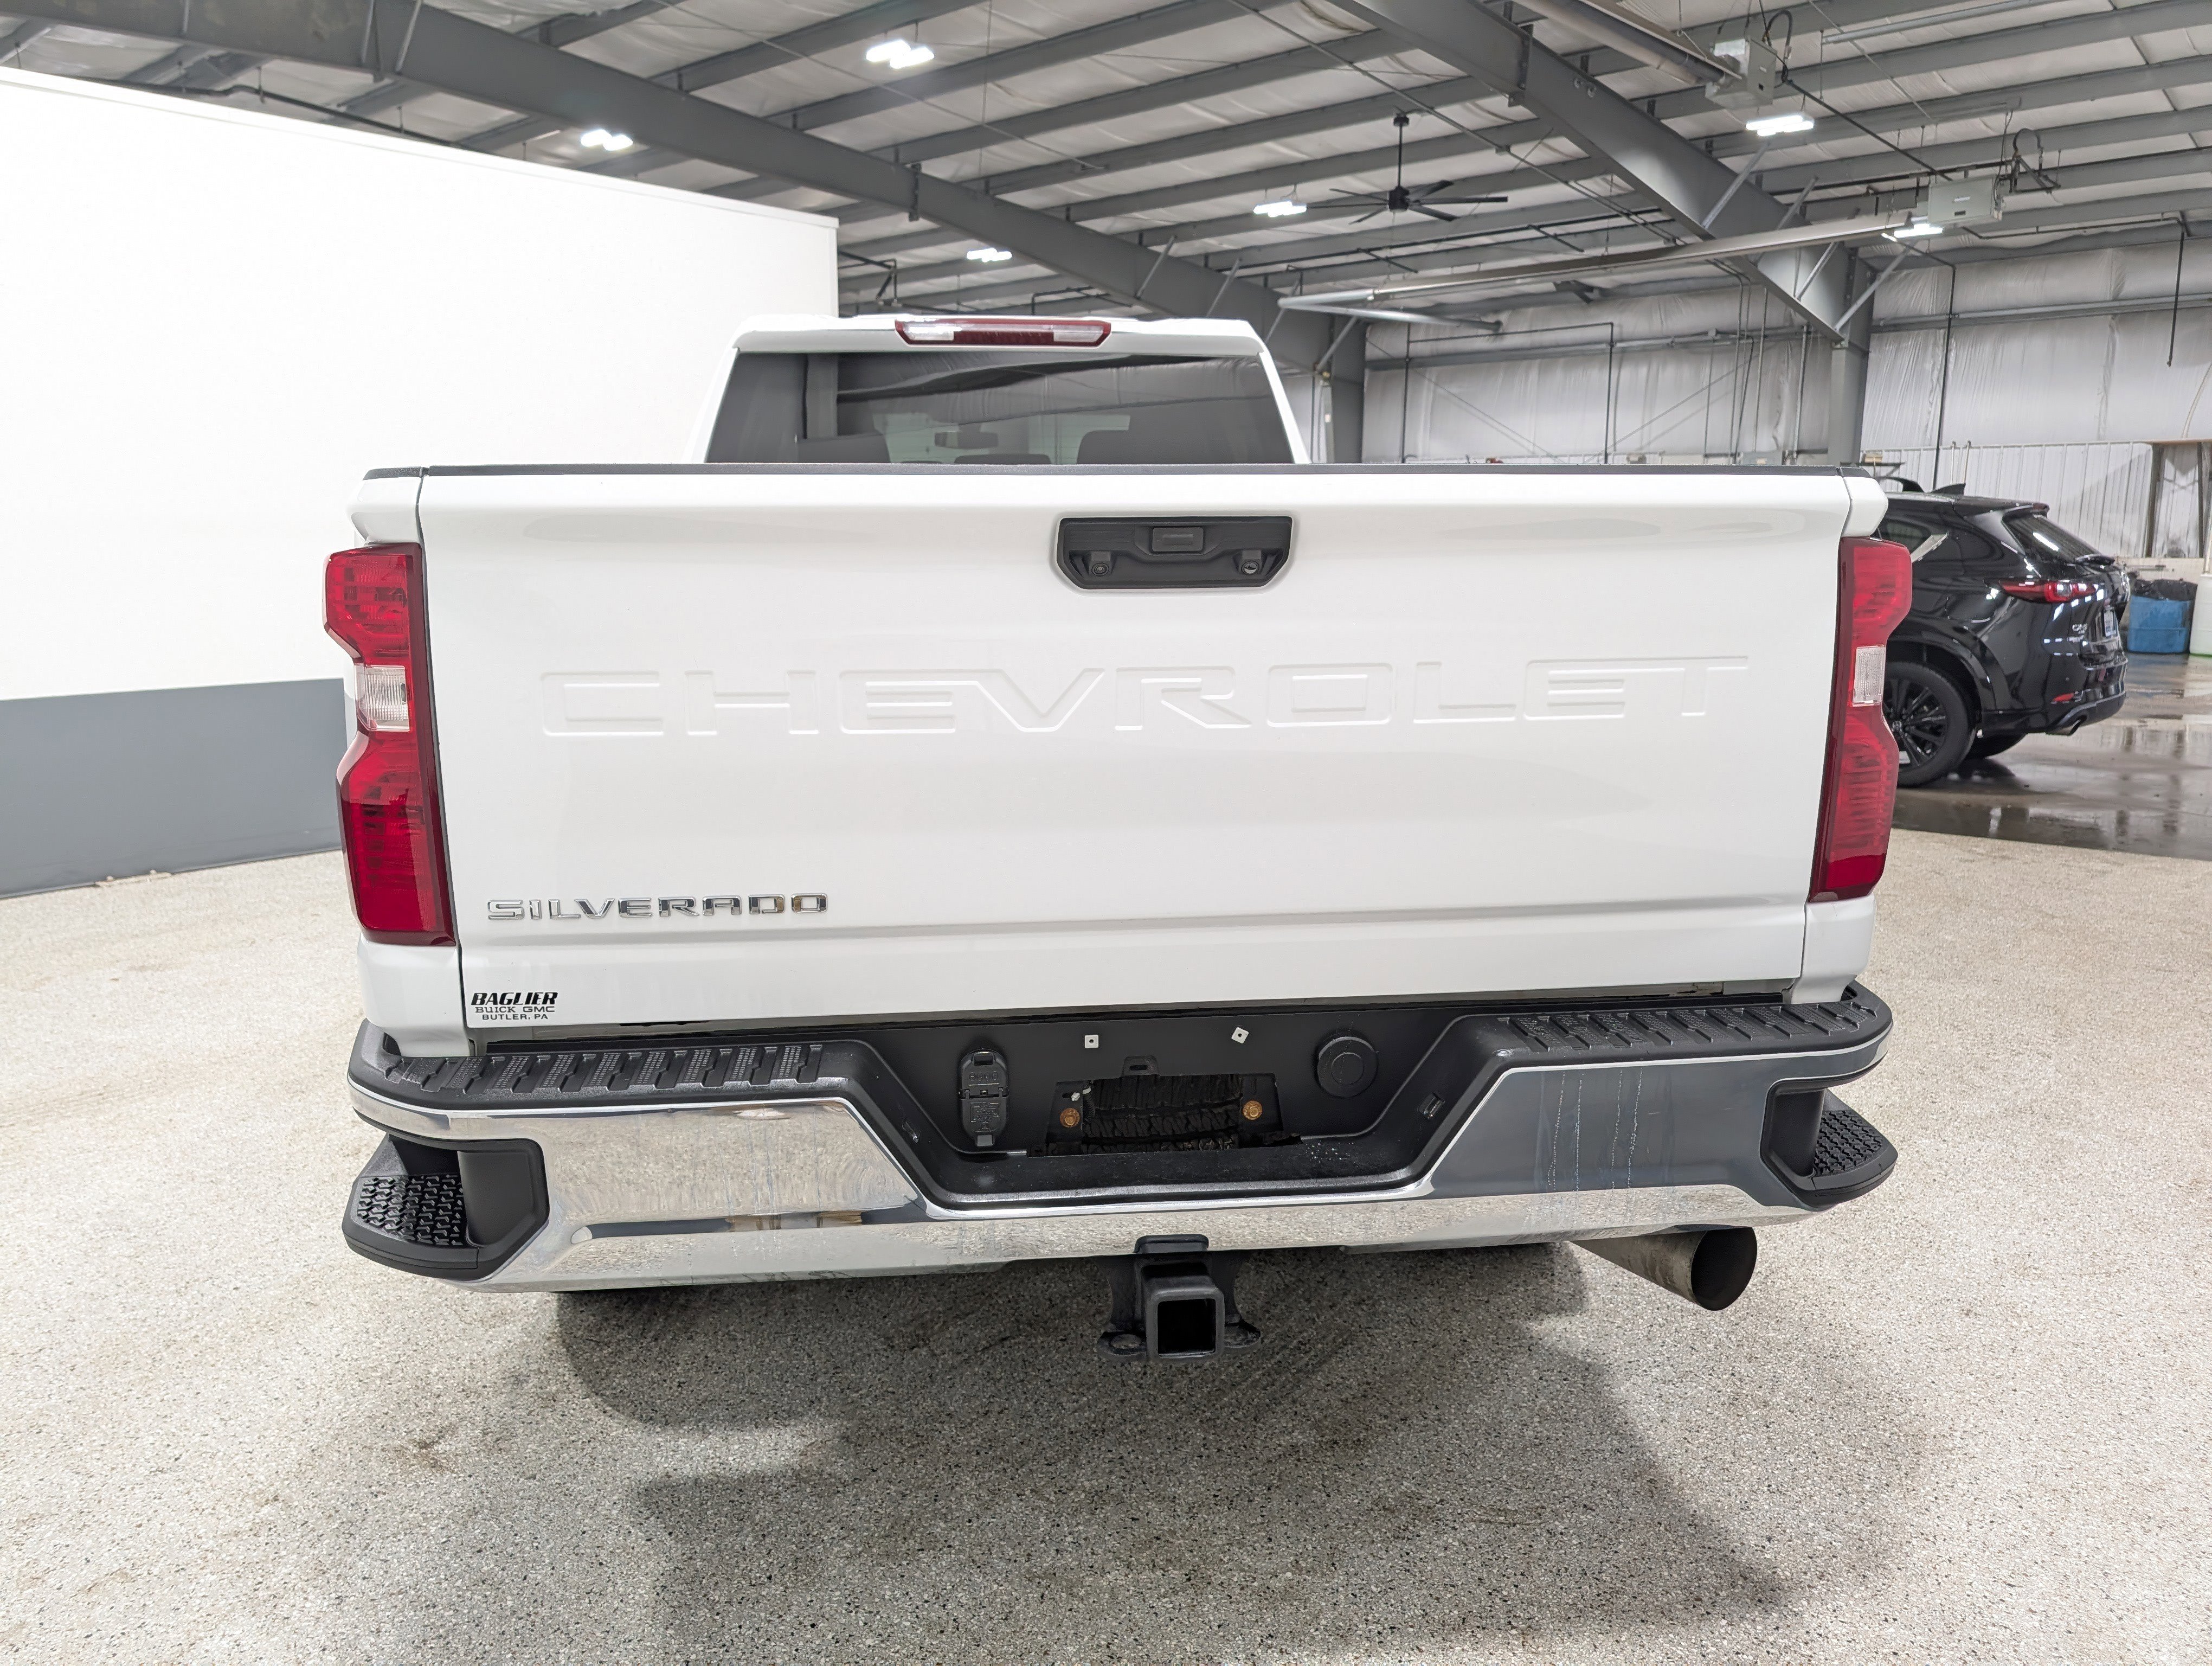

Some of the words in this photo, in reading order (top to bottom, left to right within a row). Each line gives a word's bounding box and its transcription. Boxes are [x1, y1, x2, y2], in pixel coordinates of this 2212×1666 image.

[540, 656, 1748, 736] CHEVROLET
[487, 892, 829, 920] SILVERADO
[471, 992, 558, 1005] BAGLIER
